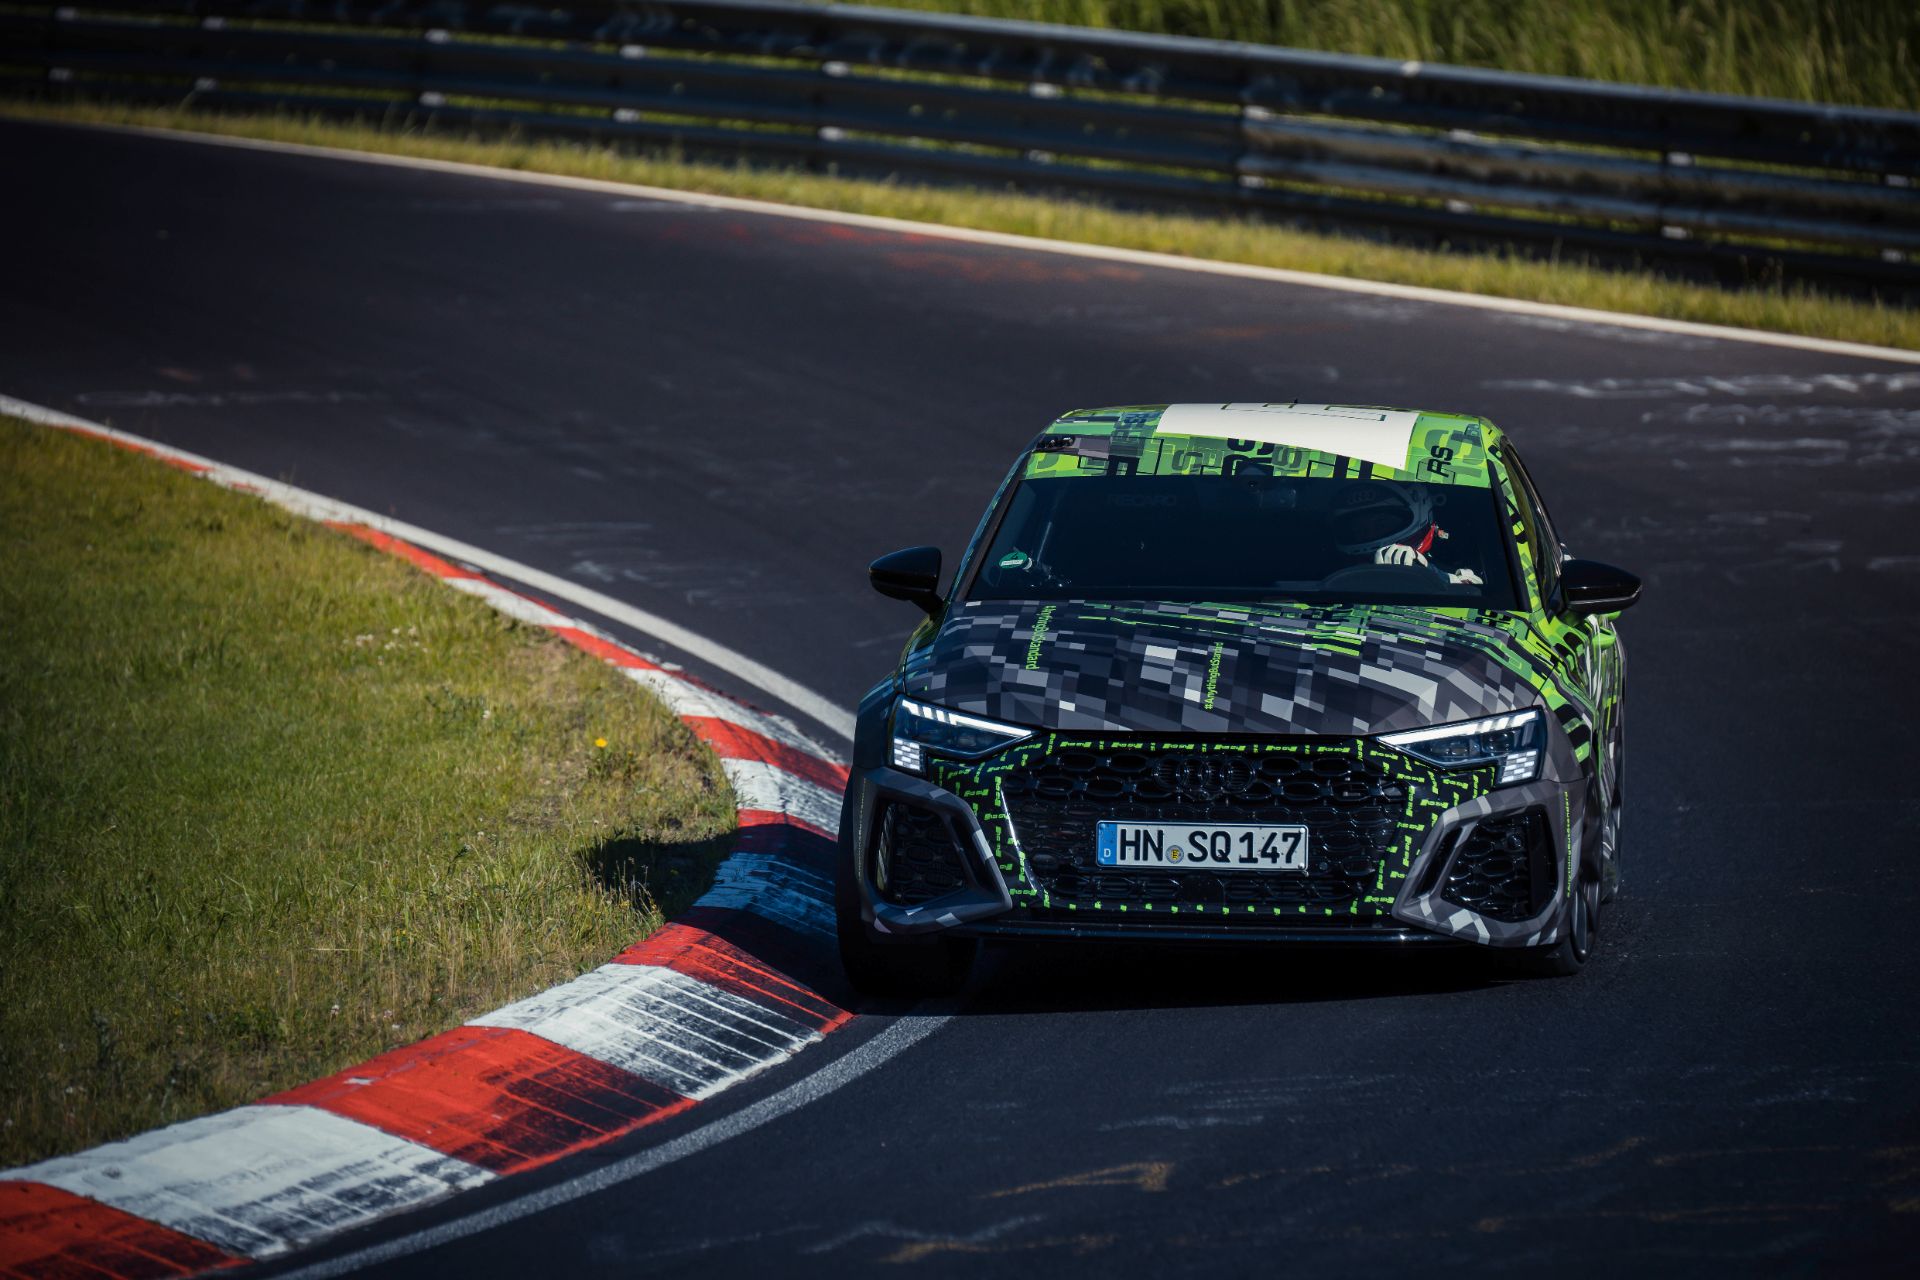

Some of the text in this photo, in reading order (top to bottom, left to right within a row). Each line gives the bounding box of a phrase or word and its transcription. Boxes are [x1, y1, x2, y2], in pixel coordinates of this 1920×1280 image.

[1427, 445, 1453, 478] RS
[1103, 848, 1111, 858] D
[1119, 828, 1303, 864] HN SQ 147
